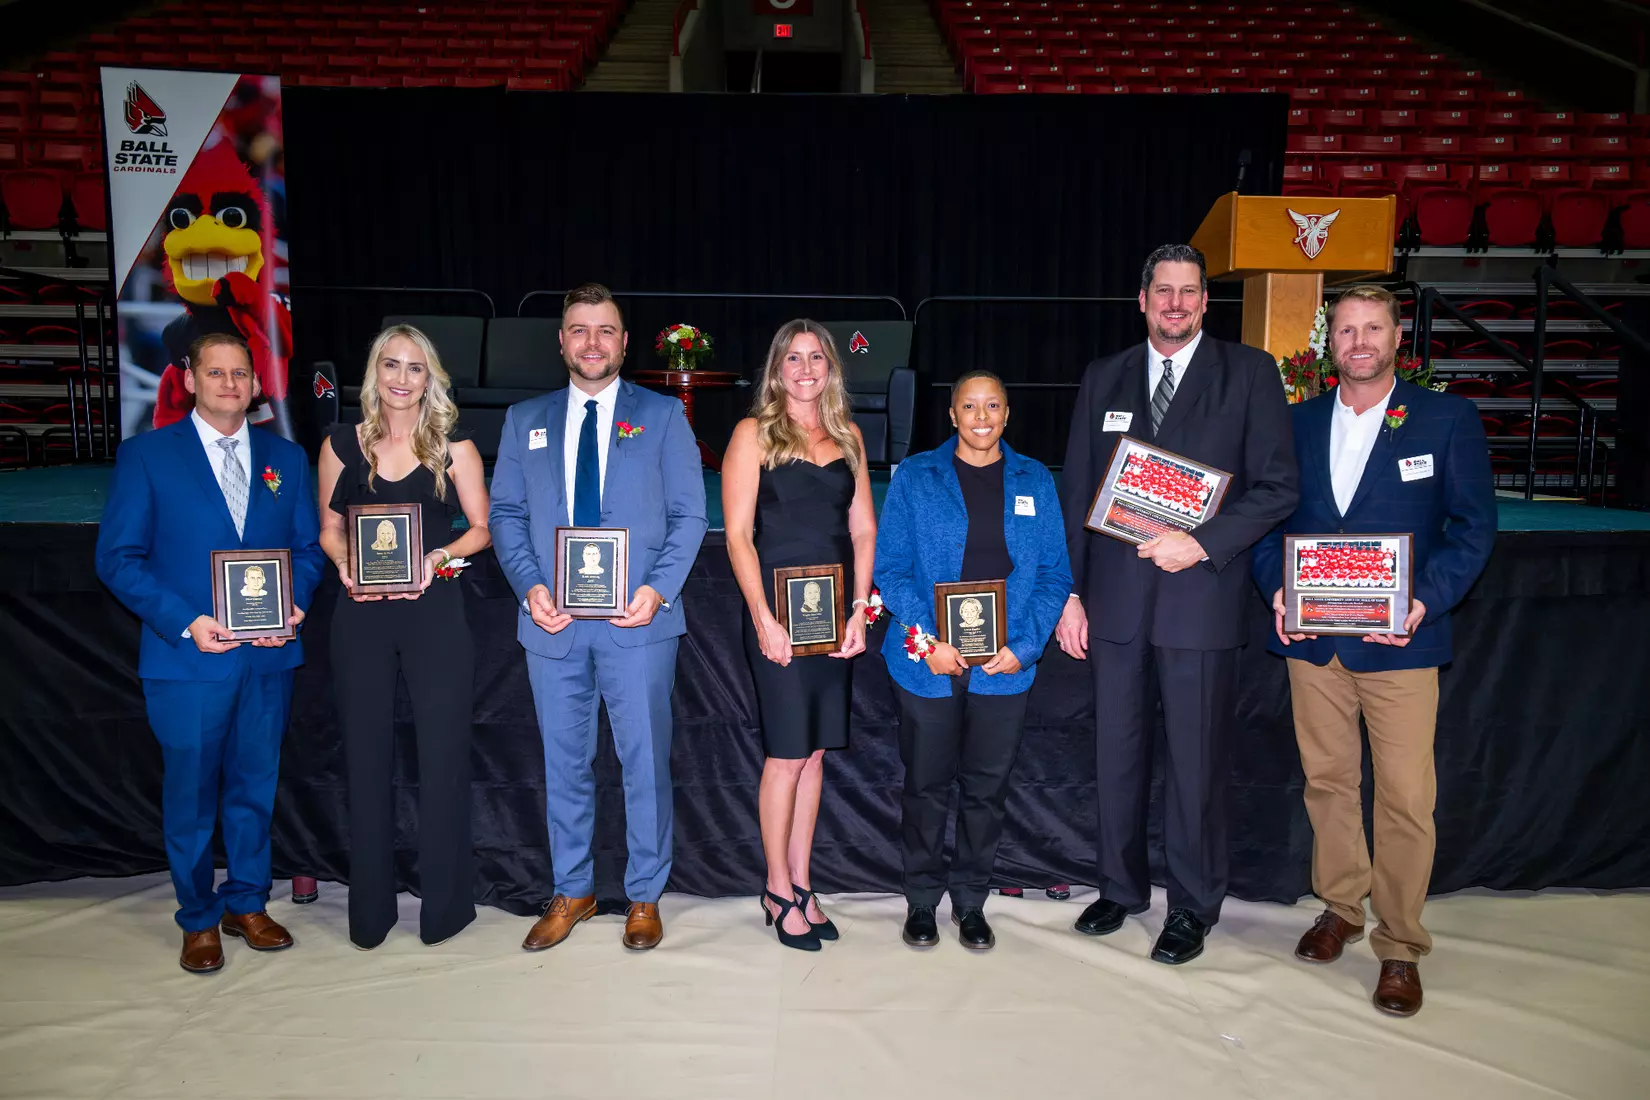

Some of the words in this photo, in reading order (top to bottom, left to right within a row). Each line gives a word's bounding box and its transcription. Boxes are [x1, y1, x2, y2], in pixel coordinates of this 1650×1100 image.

[776, 24, 791, 37] EXIT
[120, 140, 173, 153] BALL
[115, 153, 178, 166] STATE
[113, 166, 176, 174] CARDINALS
